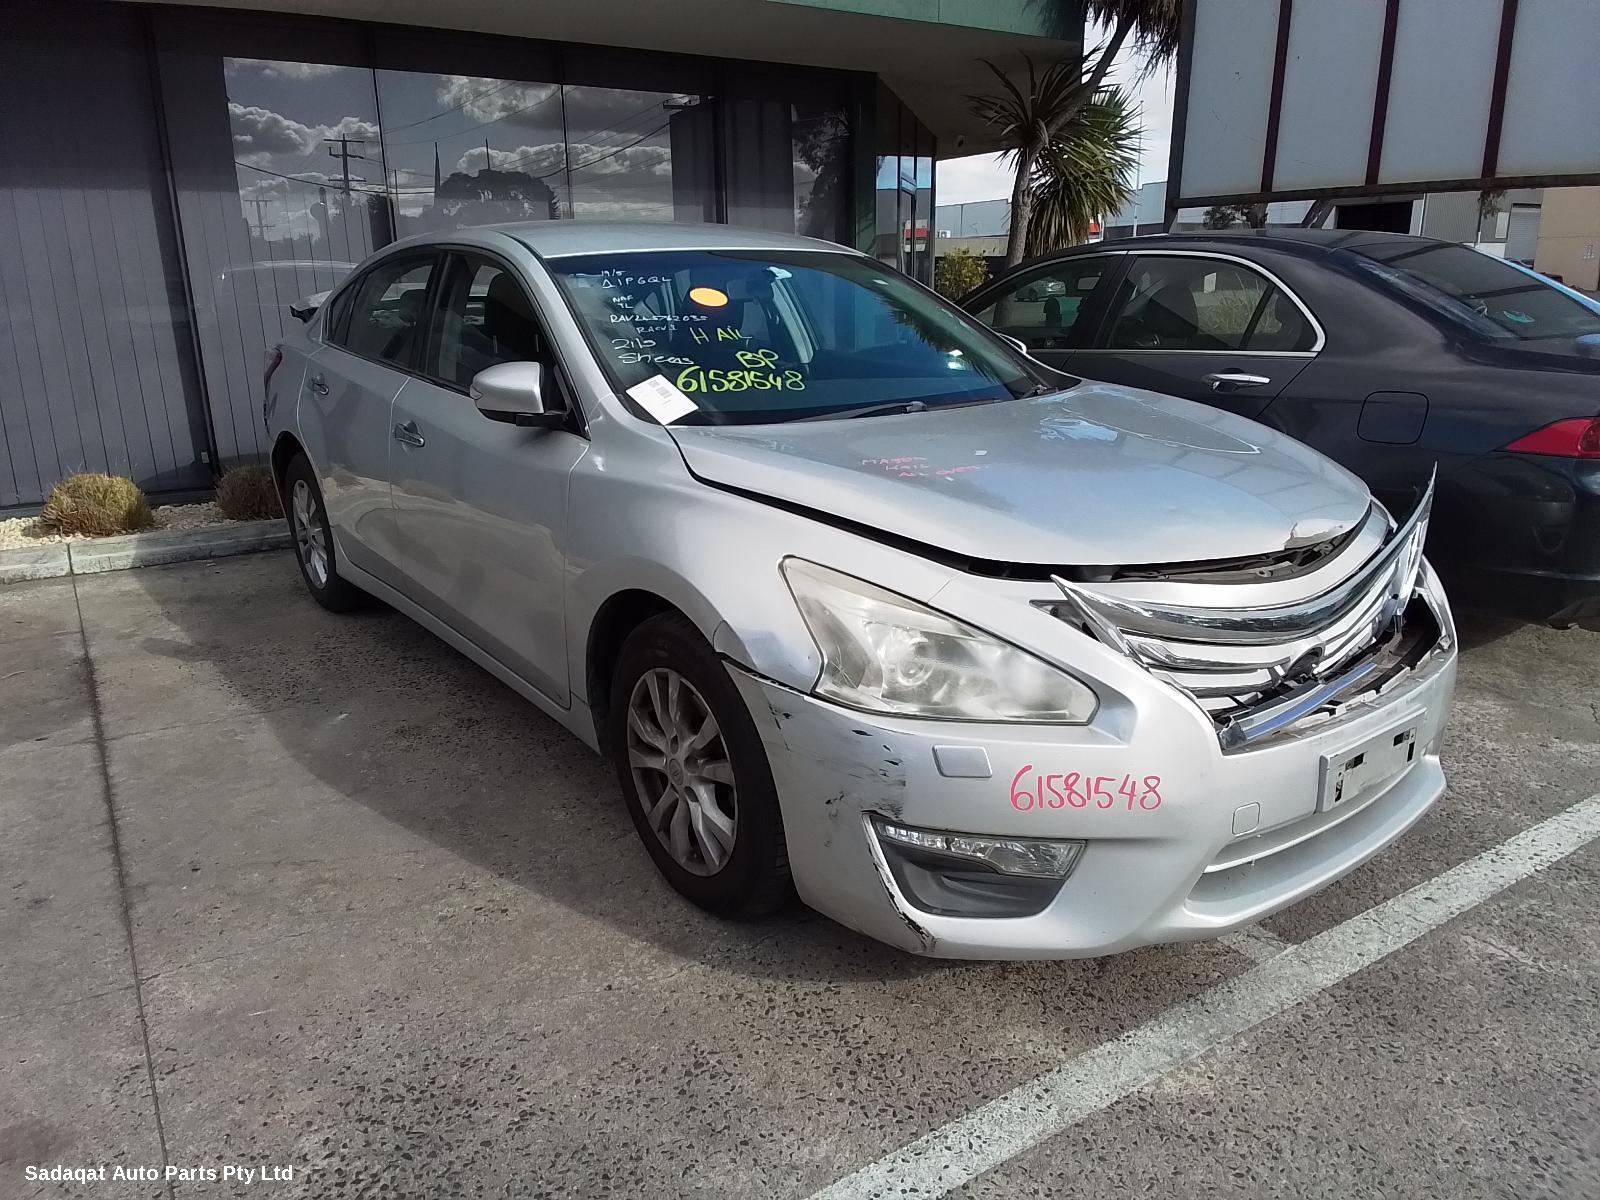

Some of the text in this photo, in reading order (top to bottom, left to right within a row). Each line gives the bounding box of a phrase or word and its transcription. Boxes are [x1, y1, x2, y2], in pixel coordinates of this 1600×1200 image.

[735, 348, 779, 369] BP
[676, 365, 805, 393] 61581548
[1009, 764, 1162, 811] 61581548
